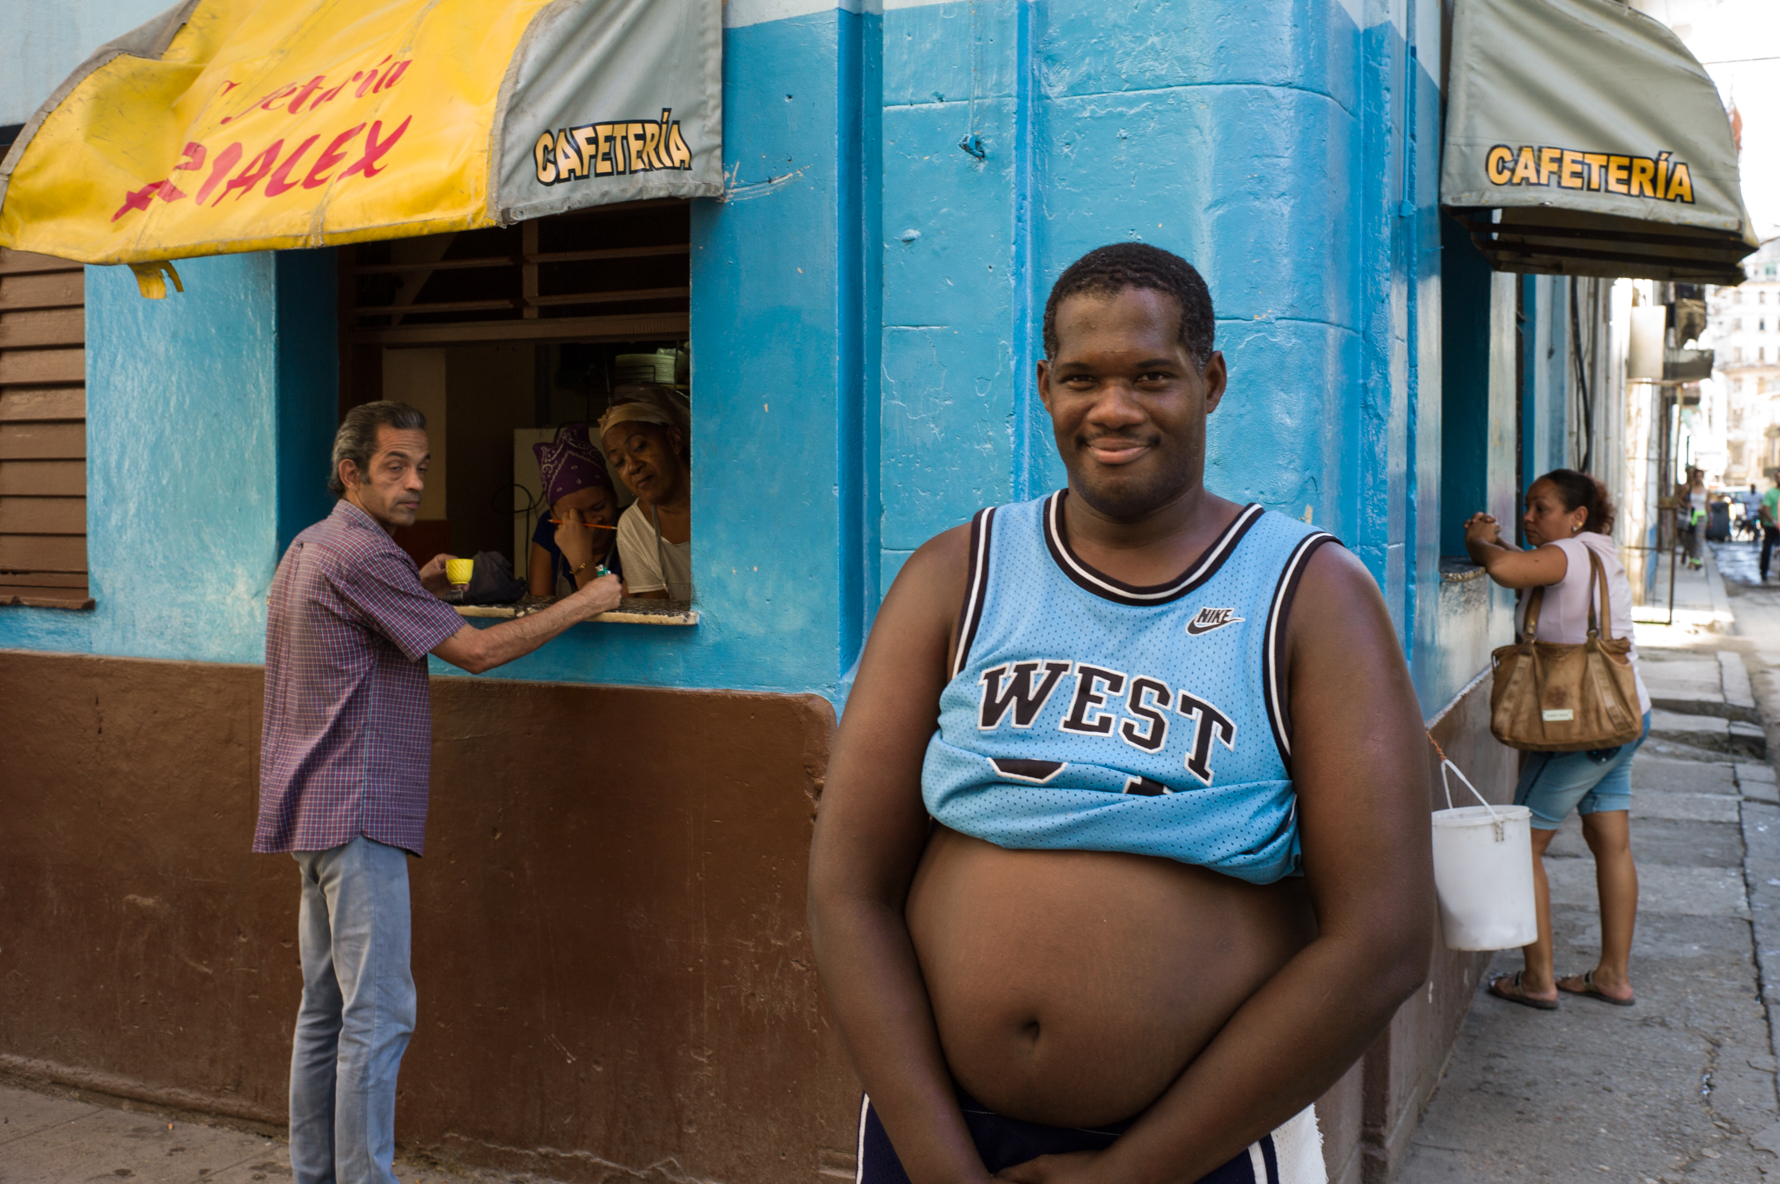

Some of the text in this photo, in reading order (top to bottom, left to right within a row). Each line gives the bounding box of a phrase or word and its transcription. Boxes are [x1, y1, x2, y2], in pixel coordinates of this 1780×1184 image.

[534, 107, 693, 186] CAFETERÍA
[1485, 144, 1696, 204] CAFETERÍA
[1196, 607, 1234, 624] NIKE
[978, 659, 1238, 788] WEST
